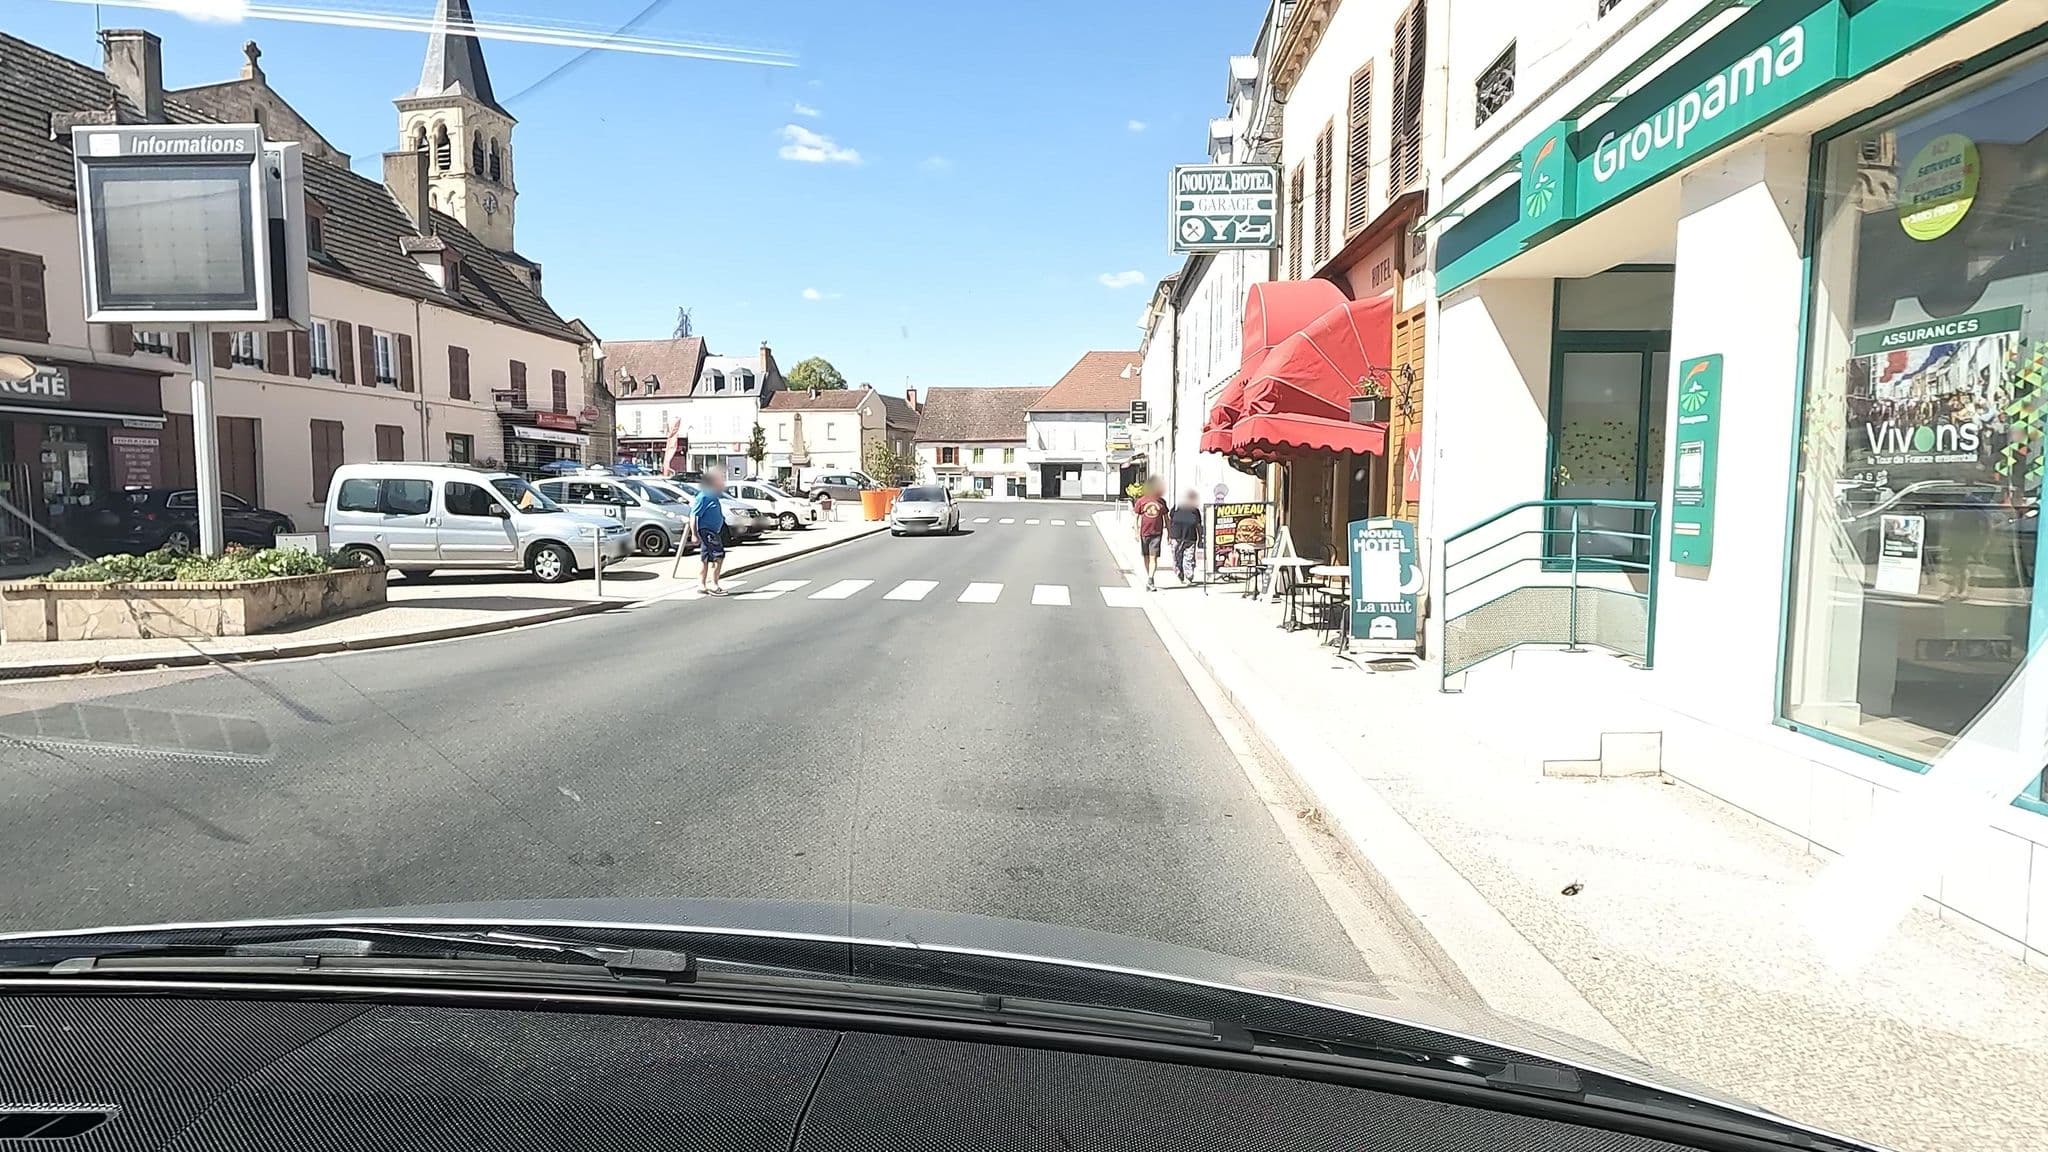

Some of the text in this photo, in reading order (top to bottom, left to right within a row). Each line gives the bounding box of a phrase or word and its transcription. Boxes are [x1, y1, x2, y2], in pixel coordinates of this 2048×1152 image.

[1593, 24, 1805, 182] Groupama
[131, 135, 245, 153] Informations
[1181, 171, 1272, 192] NOUVEL HOTEL
[1198, 197, 1255, 212] GARAGE
[1371, 256, 1391, 290] HOTEL
[1882, 319, 1978, 346] ASSURANCES
[1866, 420, 1980, 454] Vivons
[1217, 504, 1264, 517] NOUVEAU
[1358, 529, 1404, 538] NOUVEL
[1353, 538, 1411, 553] HOTEL
[1356, 599, 1412, 613] La nuit
